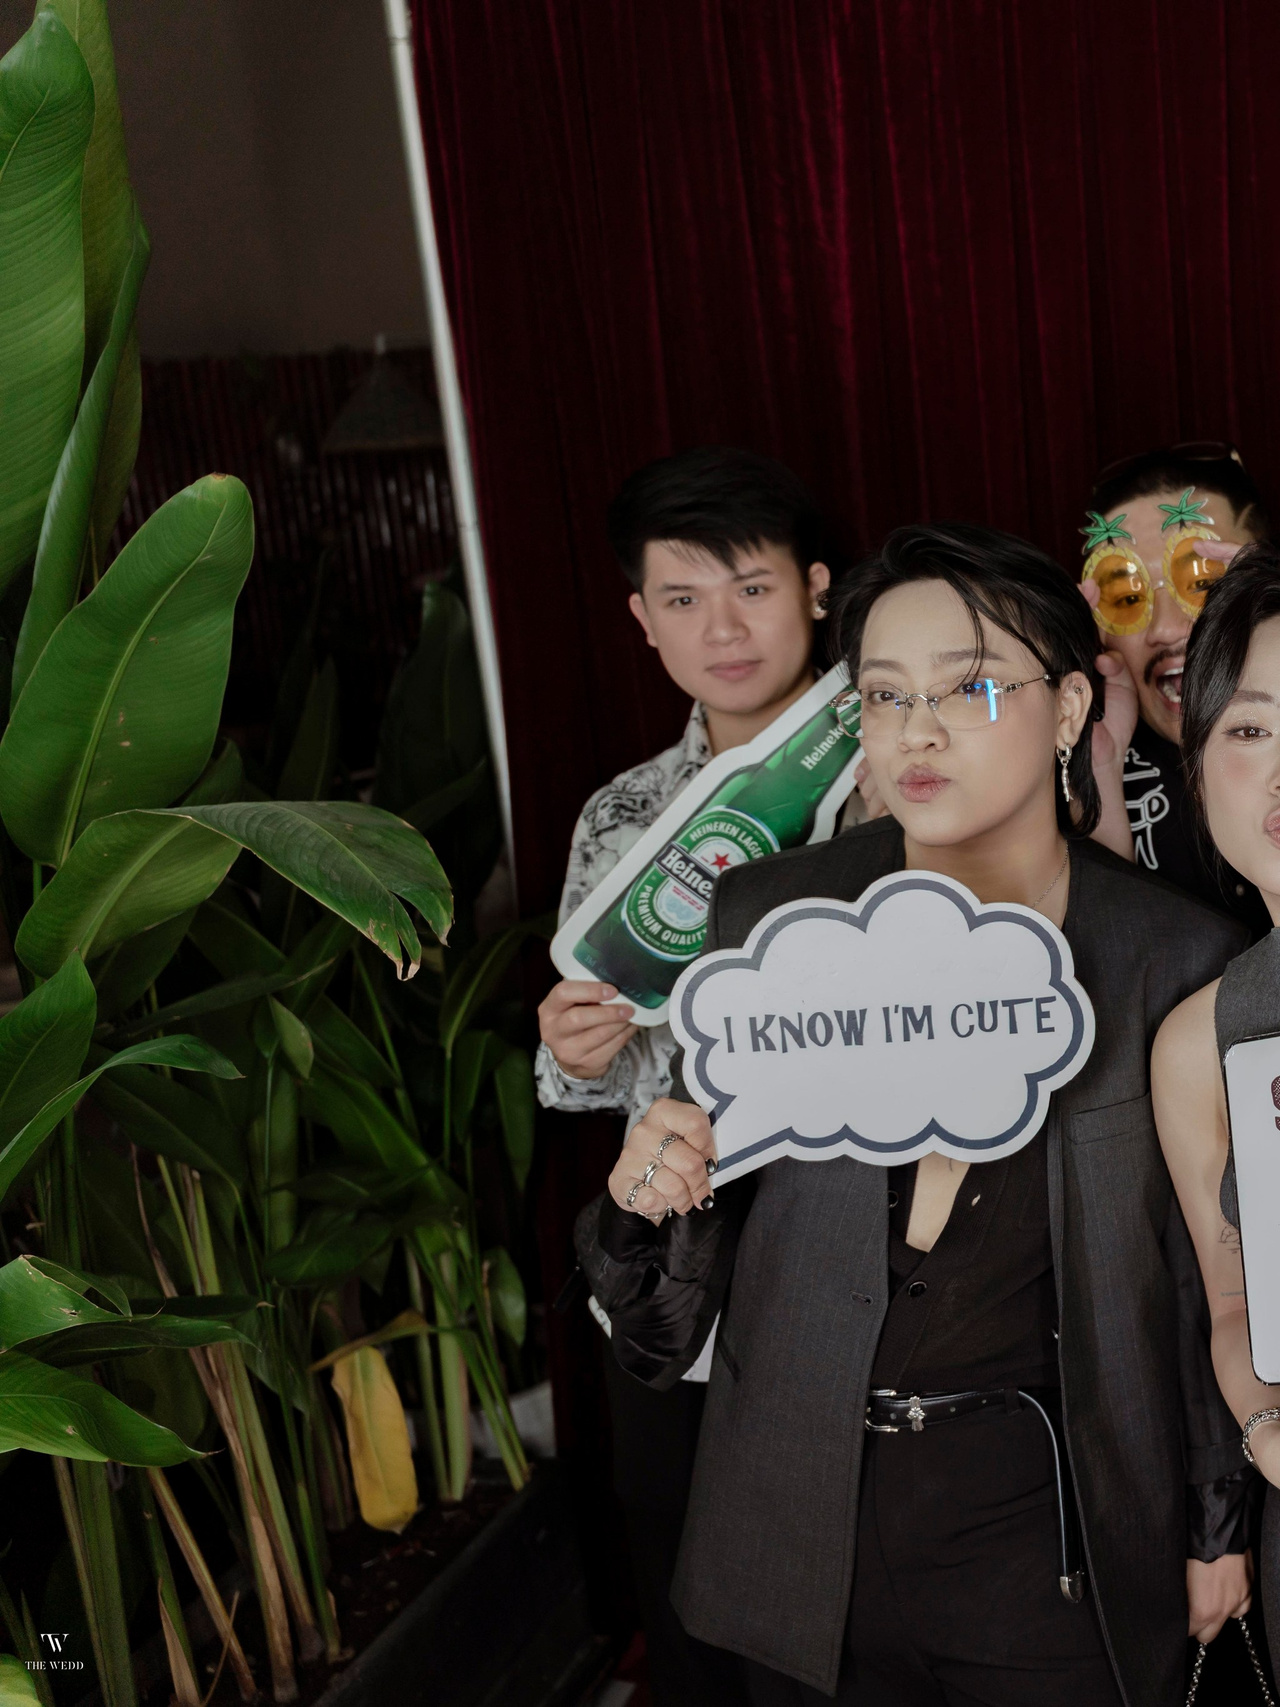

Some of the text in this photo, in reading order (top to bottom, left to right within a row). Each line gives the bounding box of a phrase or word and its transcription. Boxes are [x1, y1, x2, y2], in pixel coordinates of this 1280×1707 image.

[688, 821, 740, 842] HEINEKEN
[661, 848, 713, 899] Heine
[638, 884, 663, 935] PREMIUM
[724, 995, 1057, 1054] I KNOW I'M CUTE
